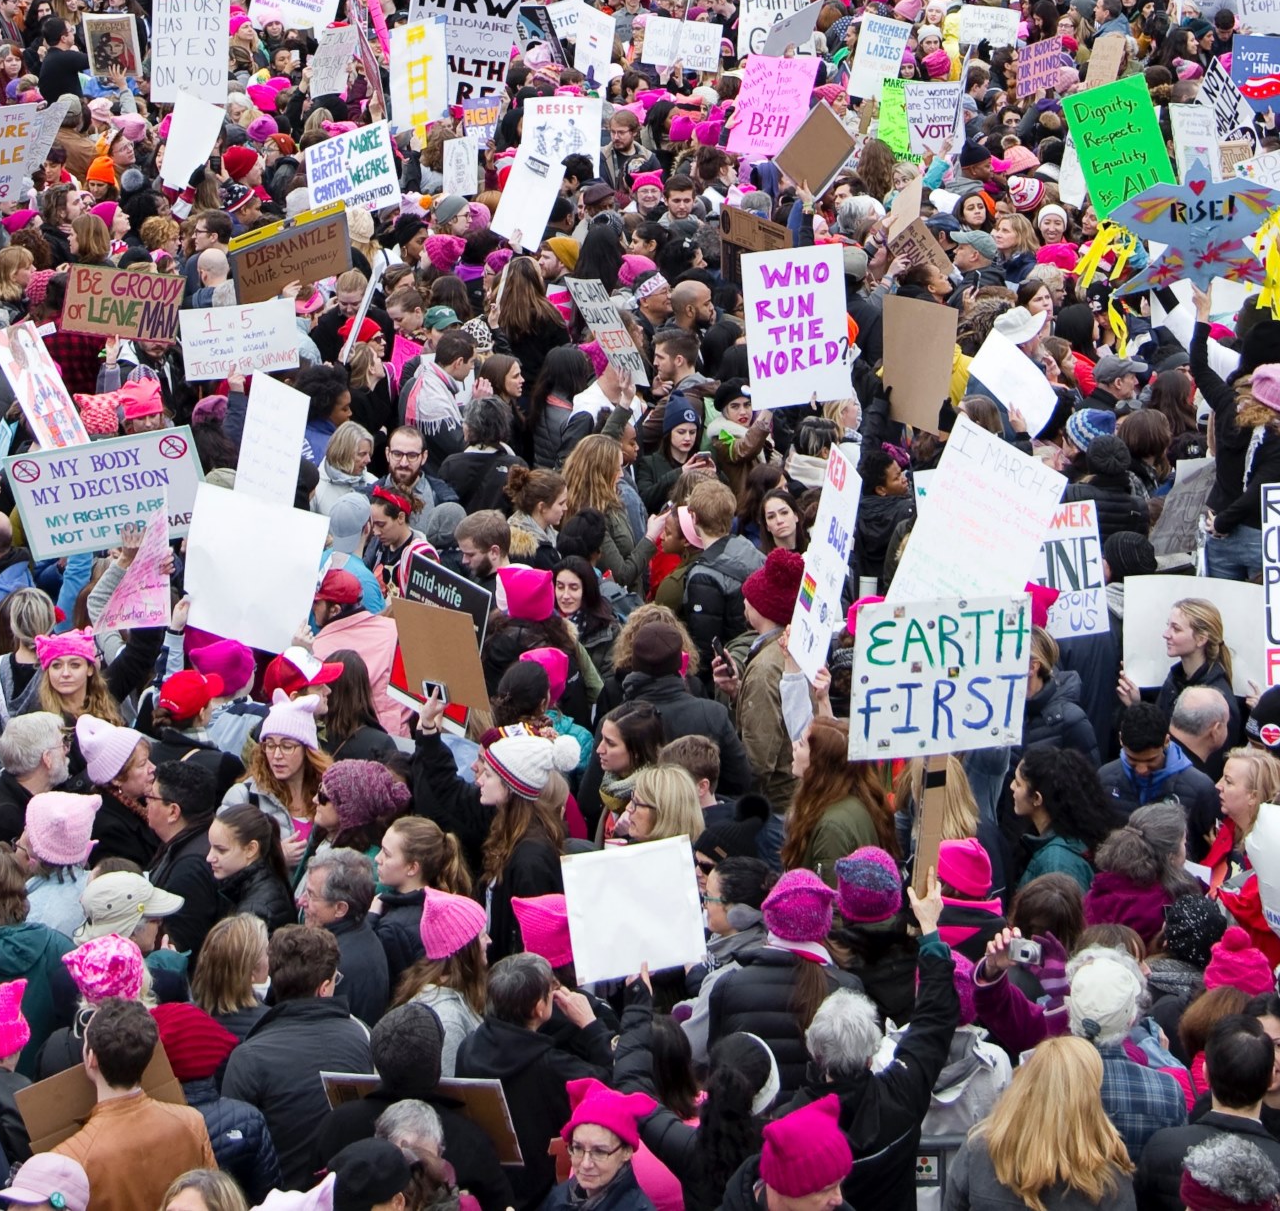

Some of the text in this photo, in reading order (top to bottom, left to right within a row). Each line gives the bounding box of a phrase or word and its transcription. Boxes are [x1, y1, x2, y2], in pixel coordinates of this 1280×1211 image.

[158, 17, 220, 33] HAS ITS
[867, 20, 909, 39] REMEMBER
[157, 38, 216, 57] EYES
[866, 45, 901, 61] LADIES
[879, 35, 892, 46] THE
[1241, 52, 1270, 62] VOTE
[156, 66, 221, 87] ON YOU
[4, 113, 25, 121] THE
[311, 141, 344, 164] LESS
[347, 127, 382, 158] MORE
[312, 158, 341, 182] BIRTH
[350, 156, 389, 187] WELFARE
[1092, 147, 1147, 174] Equality
[314, 177, 351, 203] CONTROL
[245, 223, 337, 268] DISMANTLE
[241, 250, 339, 288] White Supremacy
[760, 262, 829, 289] WHO
[77, 268, 185, 307] BE GROOVY
[67, 303, 85, 320] or
[756, 292, 814, 323] RUN
[768, 318, 824, 345] THE
[753, 336, 849, 379] WORLD?
[49, 448, 140, 479] MY BODY
[31, 468, 170, 506] MY DECISION
[45, 504, 130, 528] MY RIGHTS
[51, 527, 111, 546] NOT UP
[411, 568, 462, 607] mid-wife
[867, 606, 1029, 668] EARTH
[858, 673, 1029, 739] FIRST
